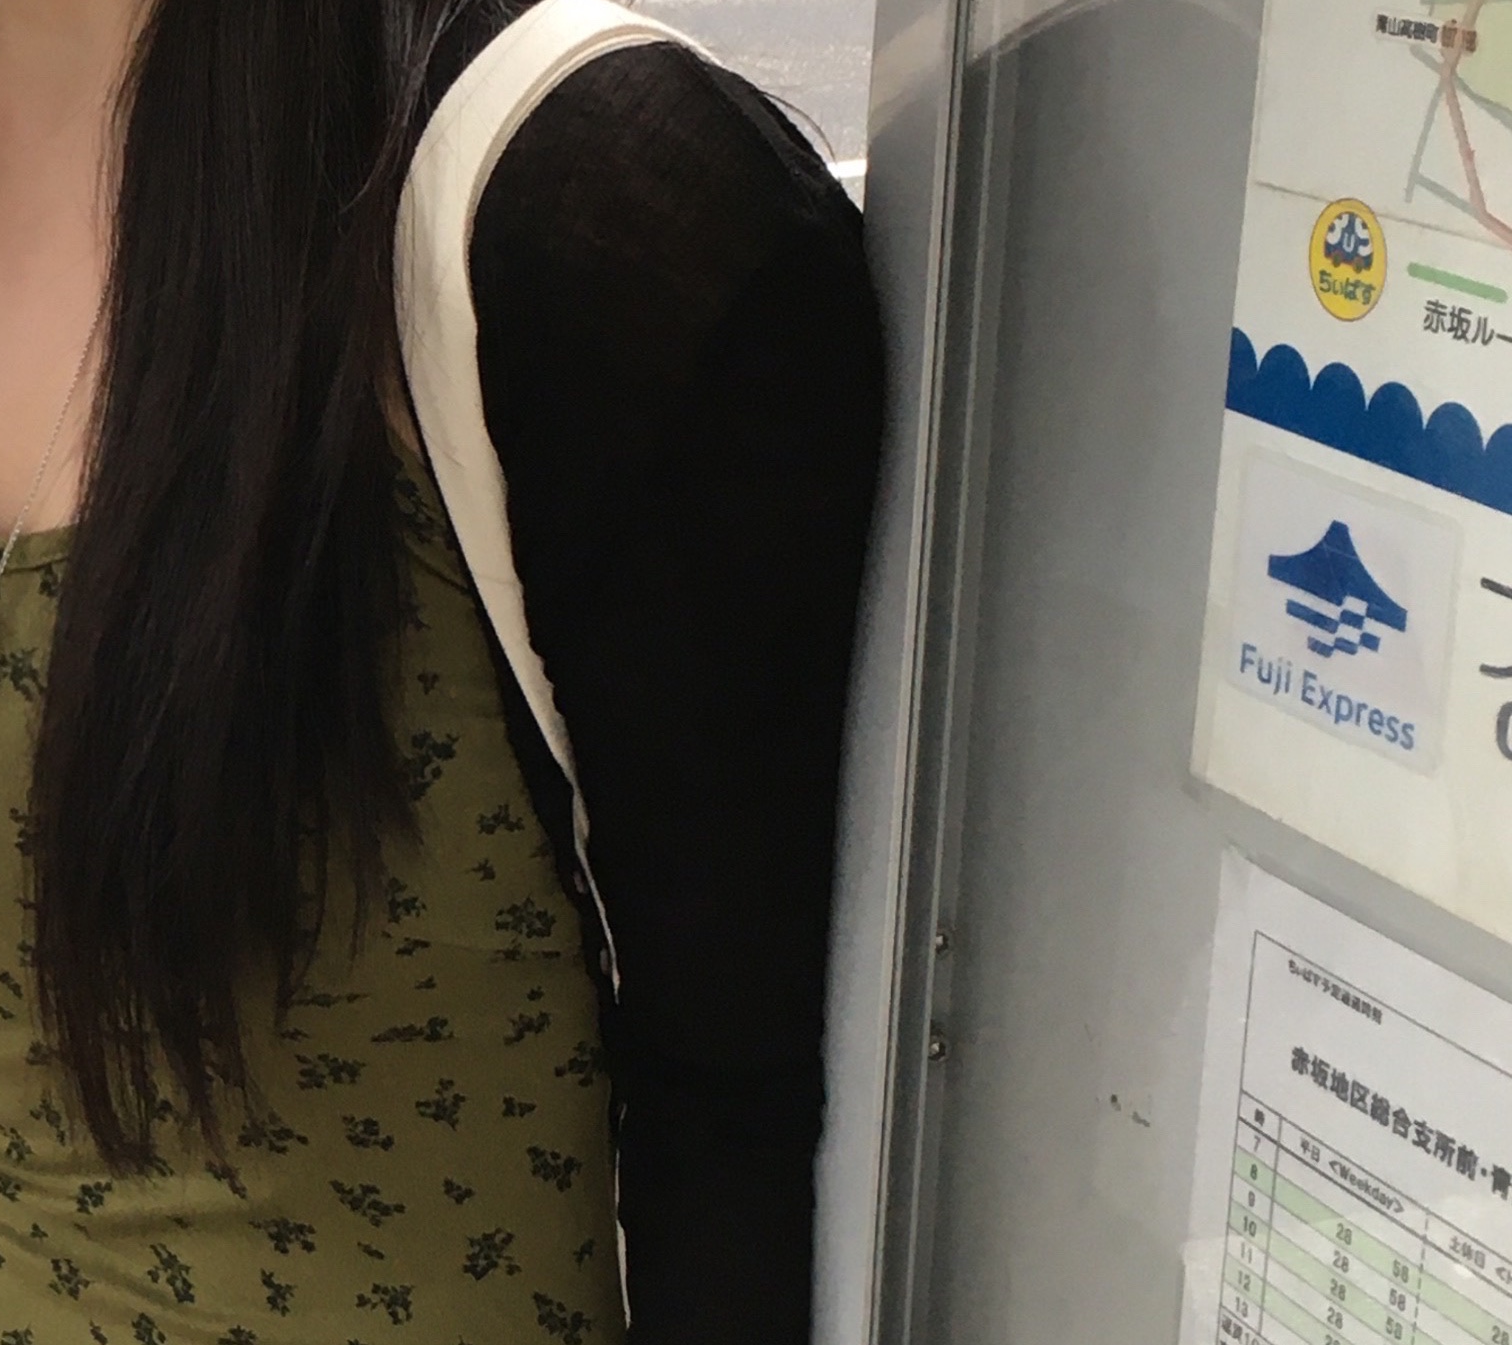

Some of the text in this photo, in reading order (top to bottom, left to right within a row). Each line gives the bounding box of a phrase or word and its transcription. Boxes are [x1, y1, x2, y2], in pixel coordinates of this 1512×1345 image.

[1239, 641, 1292, 694] Fuji
[1301, 670, 1416, 751] Express
[1254, 1134, 1261, 1152] 7
[1250, 1164, 1257, 1181] 8
[1336, 1223, 1352, 1245] 28
[1238, 1270, 1251, 1292] 12
[1240, 1242, 1253, 1264] 11
[1328, 1307, 1343, 1329] 28
[1244, 1216, 1256, 1237] 10
[1331, 1278, 1346, 1301] 28
[1333, 1250, 1349, 1273] 28
